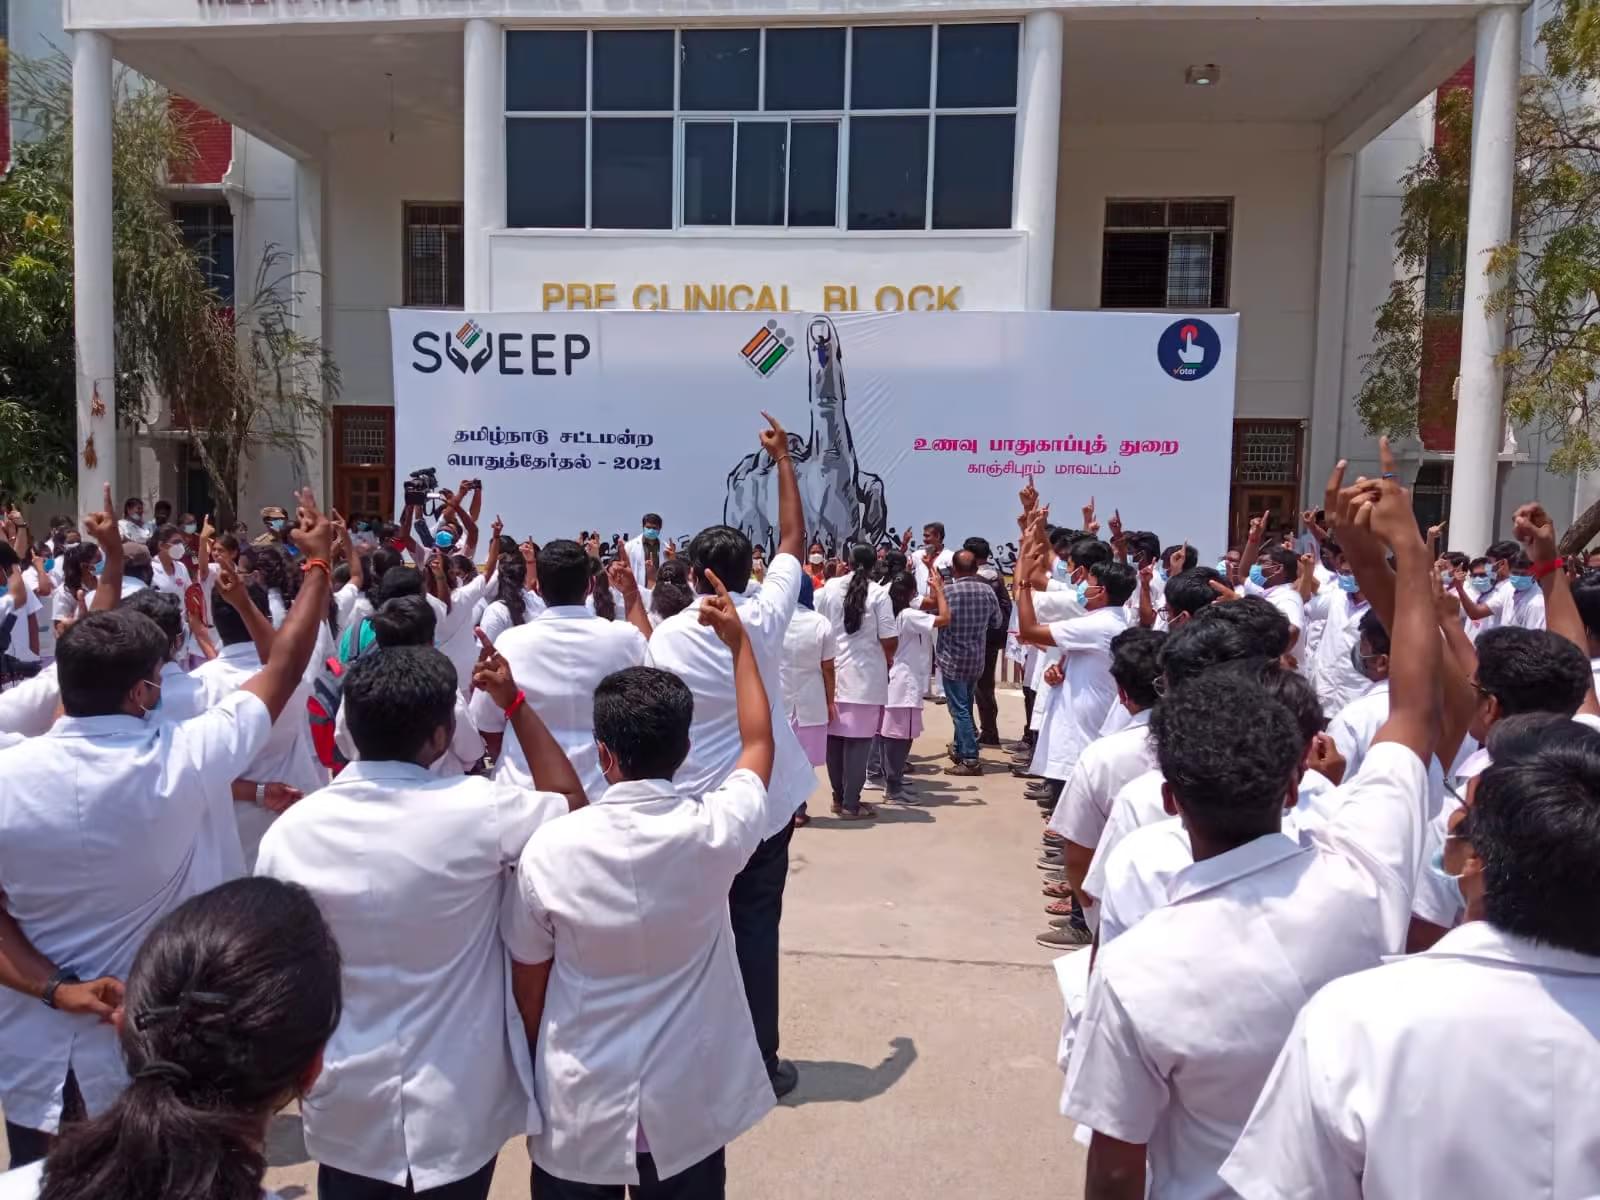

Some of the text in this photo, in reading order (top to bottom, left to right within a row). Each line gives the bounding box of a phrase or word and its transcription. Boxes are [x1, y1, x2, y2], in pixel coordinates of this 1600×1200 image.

[453, 426, 654, 447] தமிழ்நாடு சட்டமன்ற
[913, 434, 1180, 456] உணவு பாதுகாப்புத் துறை
[447, 451, 592, 471] பொதுத்தேர்தல்
[613, 456, 662, 471] 2021
[967, 459, 1122, 478] காஞ்சிபுரம் மாவட்டம்
